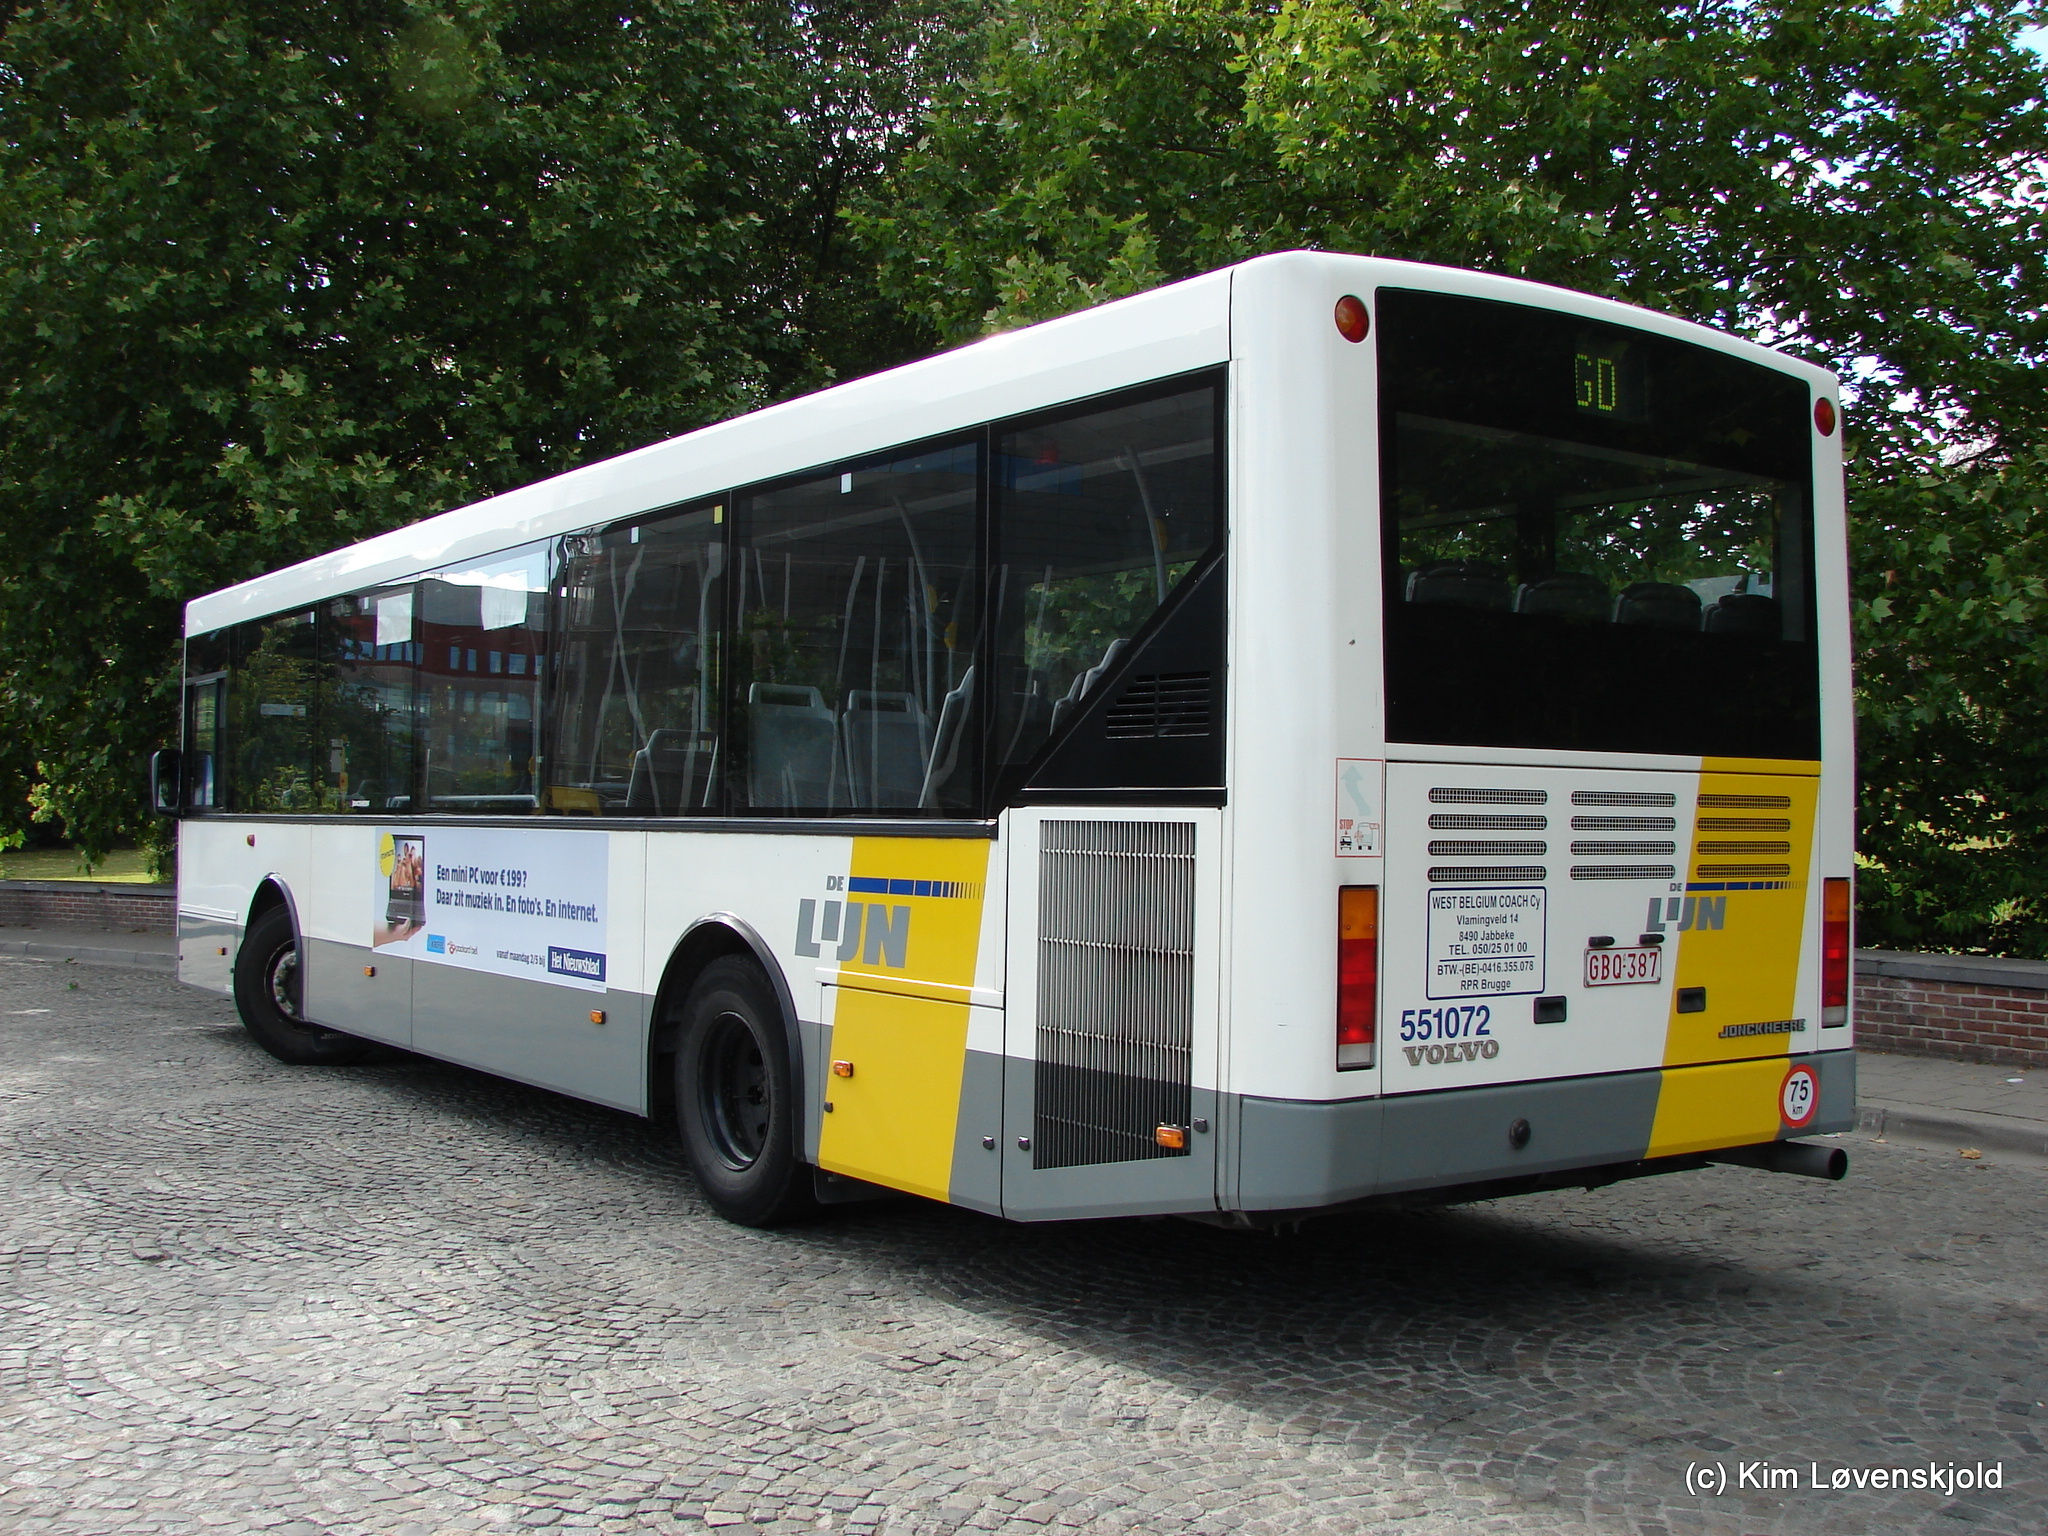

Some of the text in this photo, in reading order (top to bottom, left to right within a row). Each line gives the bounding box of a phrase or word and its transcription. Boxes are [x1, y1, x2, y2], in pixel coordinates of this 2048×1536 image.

[437, 864, 450, 881] Een
[451, 865, 468, 883] mini
[469, 867, 479, 884] PC
[480, 870, 499, 885] voor
[826, 875, 844, 891] DE
[1669, 882, 1683, 892] DE
[436, 888, 599, 923] Daar zit muziek in. En foto's. En internet.
[1432, 894, 1541, 910] WEST BELGIUM COACH Cy
[1456, 913, 1519, 927] Vlamingveld 14
[1646, 896, 1727, 932] LIJN
[795, 898, 911, 968] LIJN
[1459, 930, 1515, 942] 8490 Jabbeke
[1448, 942, 1527, 955] TEL. 050/25 01 00
[496, 950, 508, 960] vanaf
[509, 952, 530, 965] maandag
[551, 951, 600, 976] Het Nieuwsblad
[1460, 978, 1511, 991] RPR Brugge
[1400, 1005, 1490, 1041] 551072
[1718, 1019, 1806, 1038] JONCKHEERE
[1402, 1039, 1499, 1066] VOLVO
[1790, 1079, 1809, 1102] 75
[1792, 1104, 1803, 1115] km
